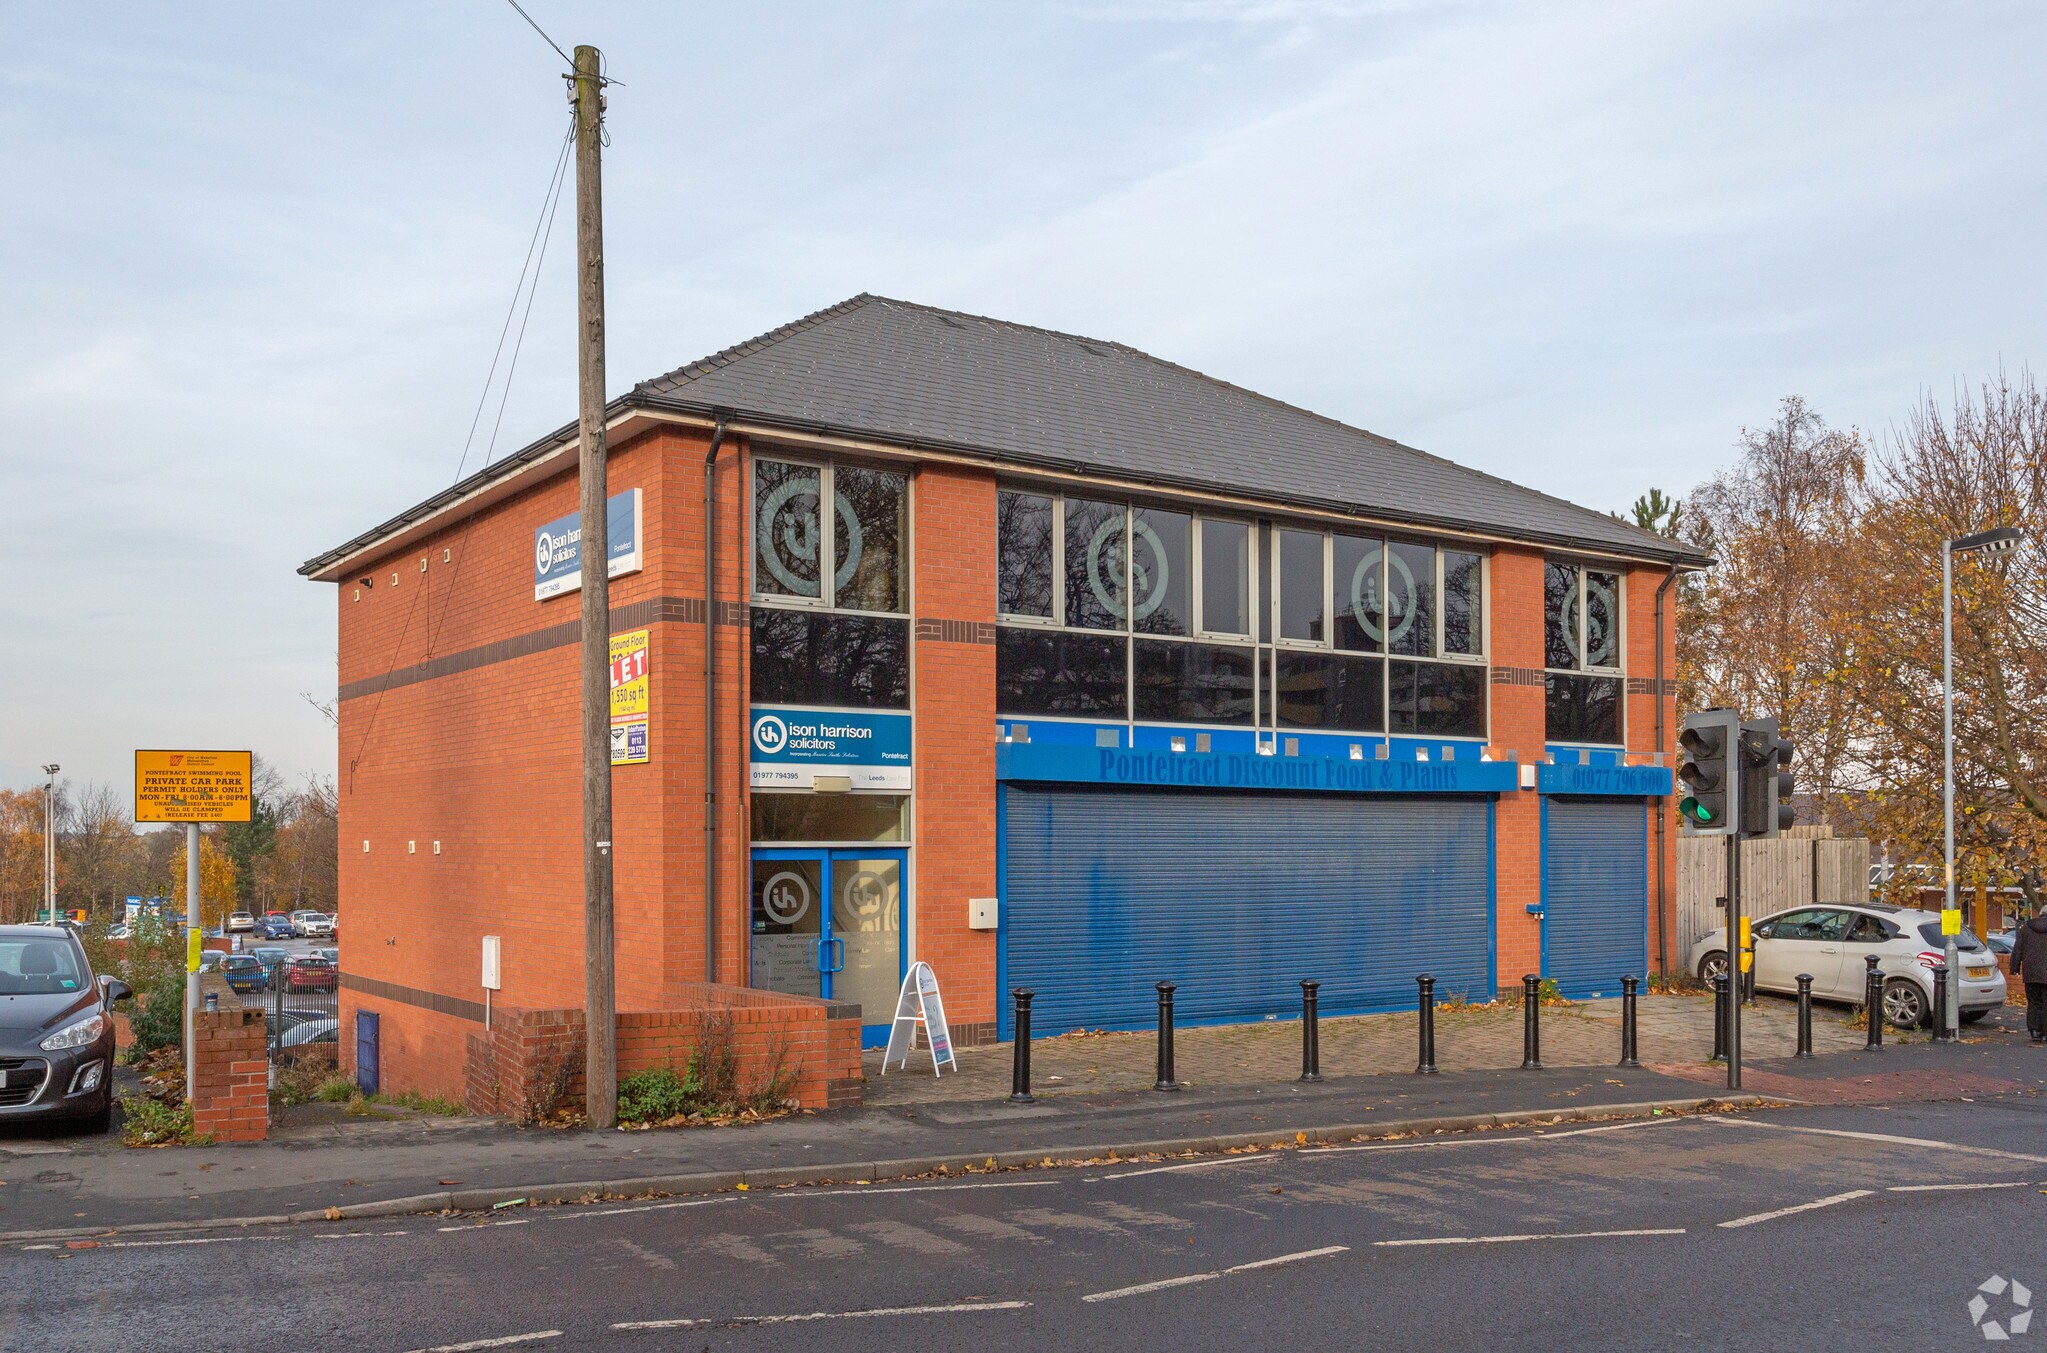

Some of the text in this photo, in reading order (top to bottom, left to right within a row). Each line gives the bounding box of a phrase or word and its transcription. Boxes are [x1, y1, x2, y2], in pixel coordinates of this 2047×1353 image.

[553, 529, 582, 549] ison harr
[614, 541, 632, 553] Pontefract
[553, 547, 577, 565] solicitors
[610, 636, 645, 651] Ground Floor
[610, 650, 644, 689] LET
[611, 685, 644, 705] 1,550 sq ft
[789, 722, 872, 739] ison harrison
[789, 738, 835, 750] solicitors
[1099, 749, 1458, 789] Pontefract Discount Food & Plants
[1572, 768, 1663, 791] 01977 796 600
